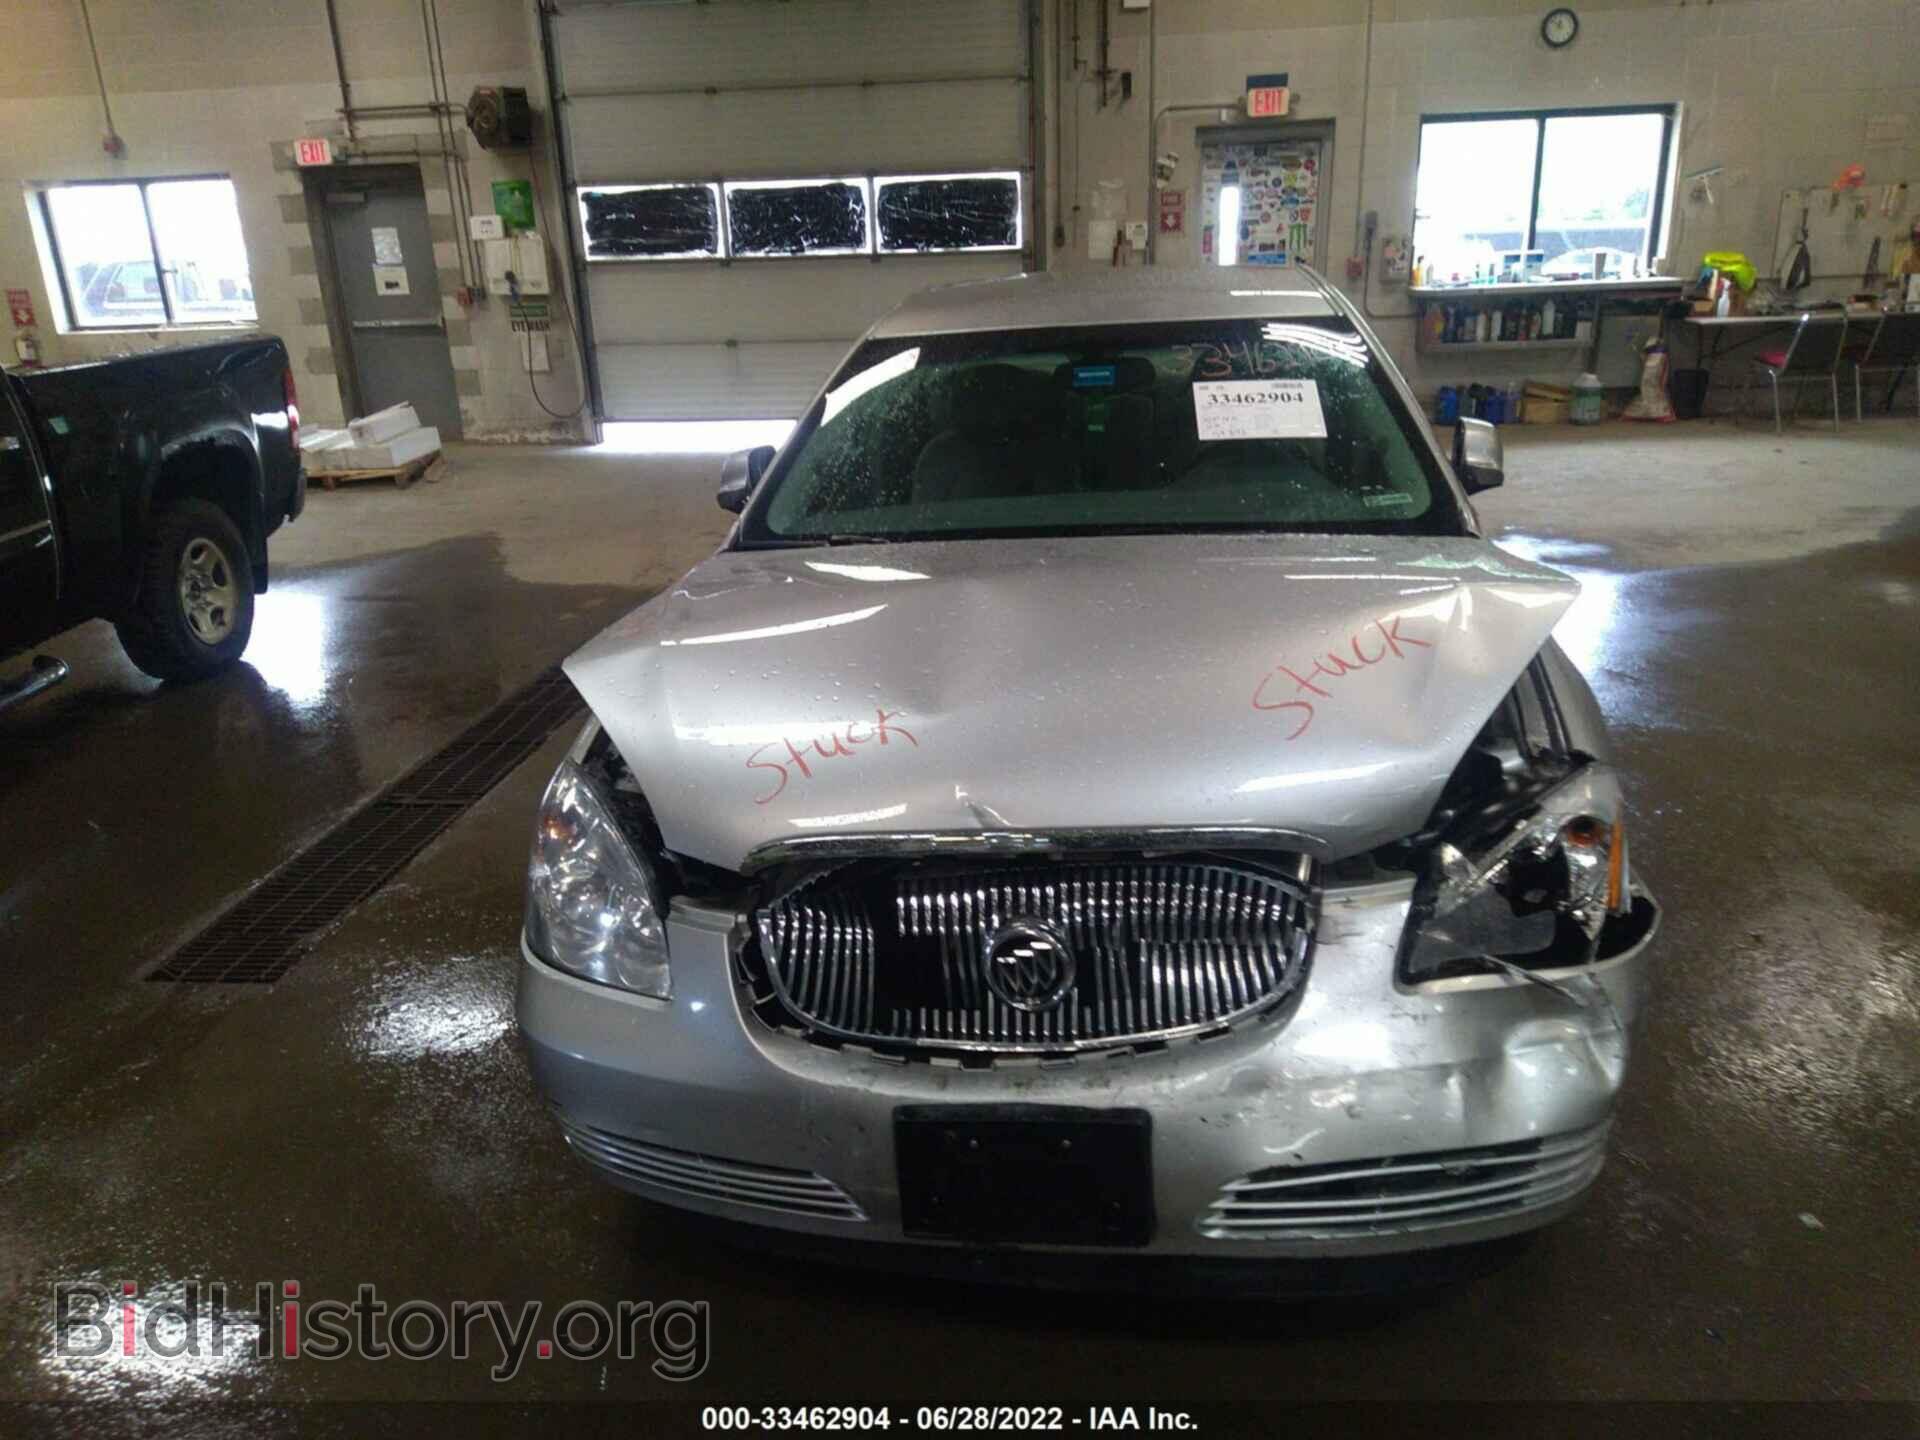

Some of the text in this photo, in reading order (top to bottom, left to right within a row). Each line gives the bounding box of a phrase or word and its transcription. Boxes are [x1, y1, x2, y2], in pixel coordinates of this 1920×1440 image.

[1254, 89, 1283, 115] EXIT
[300, 140, 326, 163] EXIT
[1207, 391, 1304, 405] 33462904
